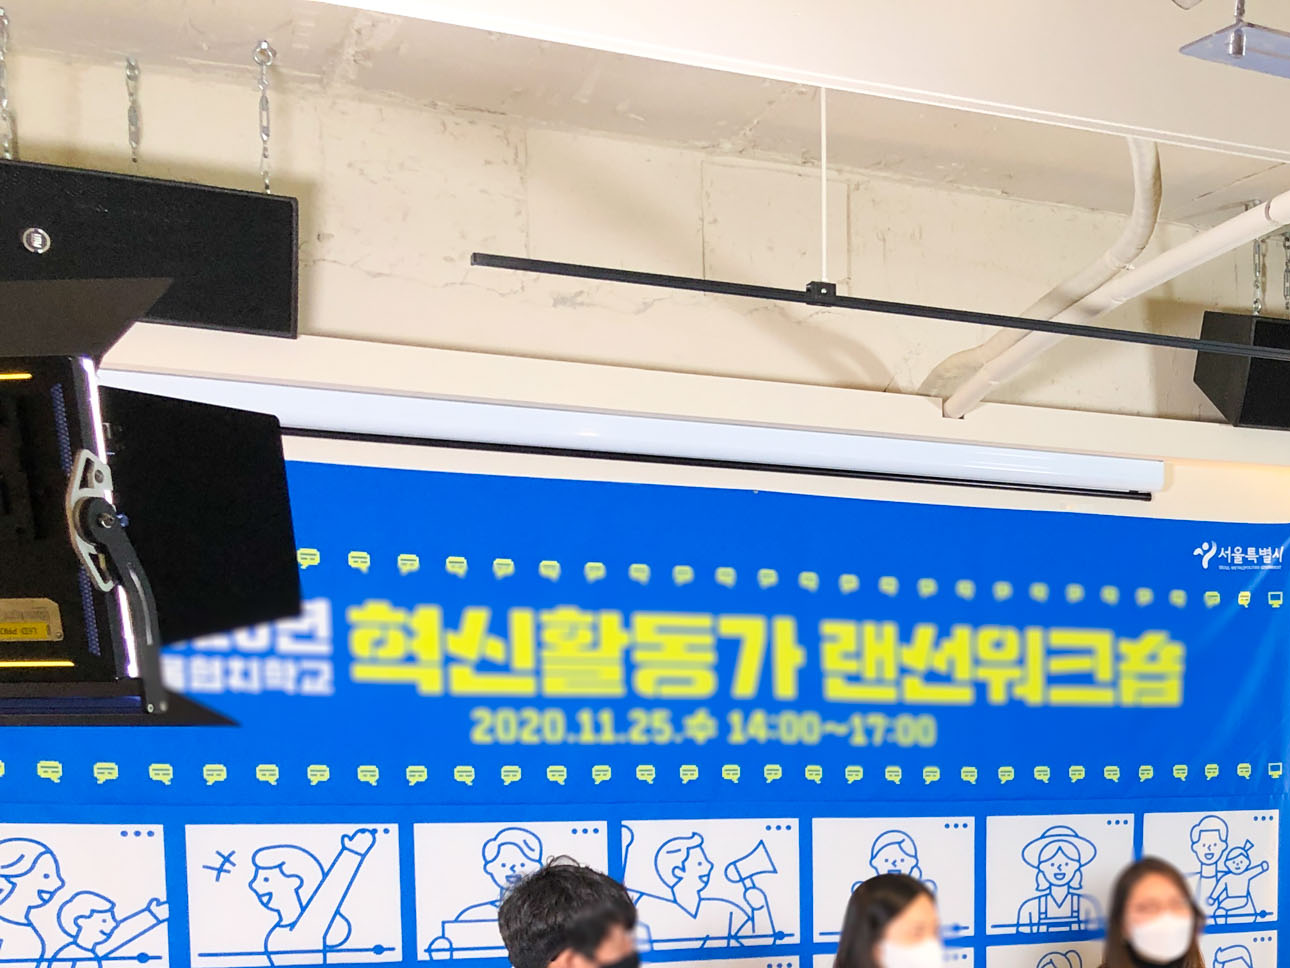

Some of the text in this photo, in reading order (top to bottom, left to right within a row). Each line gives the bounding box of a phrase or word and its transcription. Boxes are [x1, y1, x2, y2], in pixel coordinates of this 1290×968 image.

[1218, 546, 1284, 564] 서울특별시
[347, 599, 806, 698] 혁신활동가
[820, 618, 1186, 708] 랜선워크숍
[726, 708, 938, 748] 14:00~17:00
